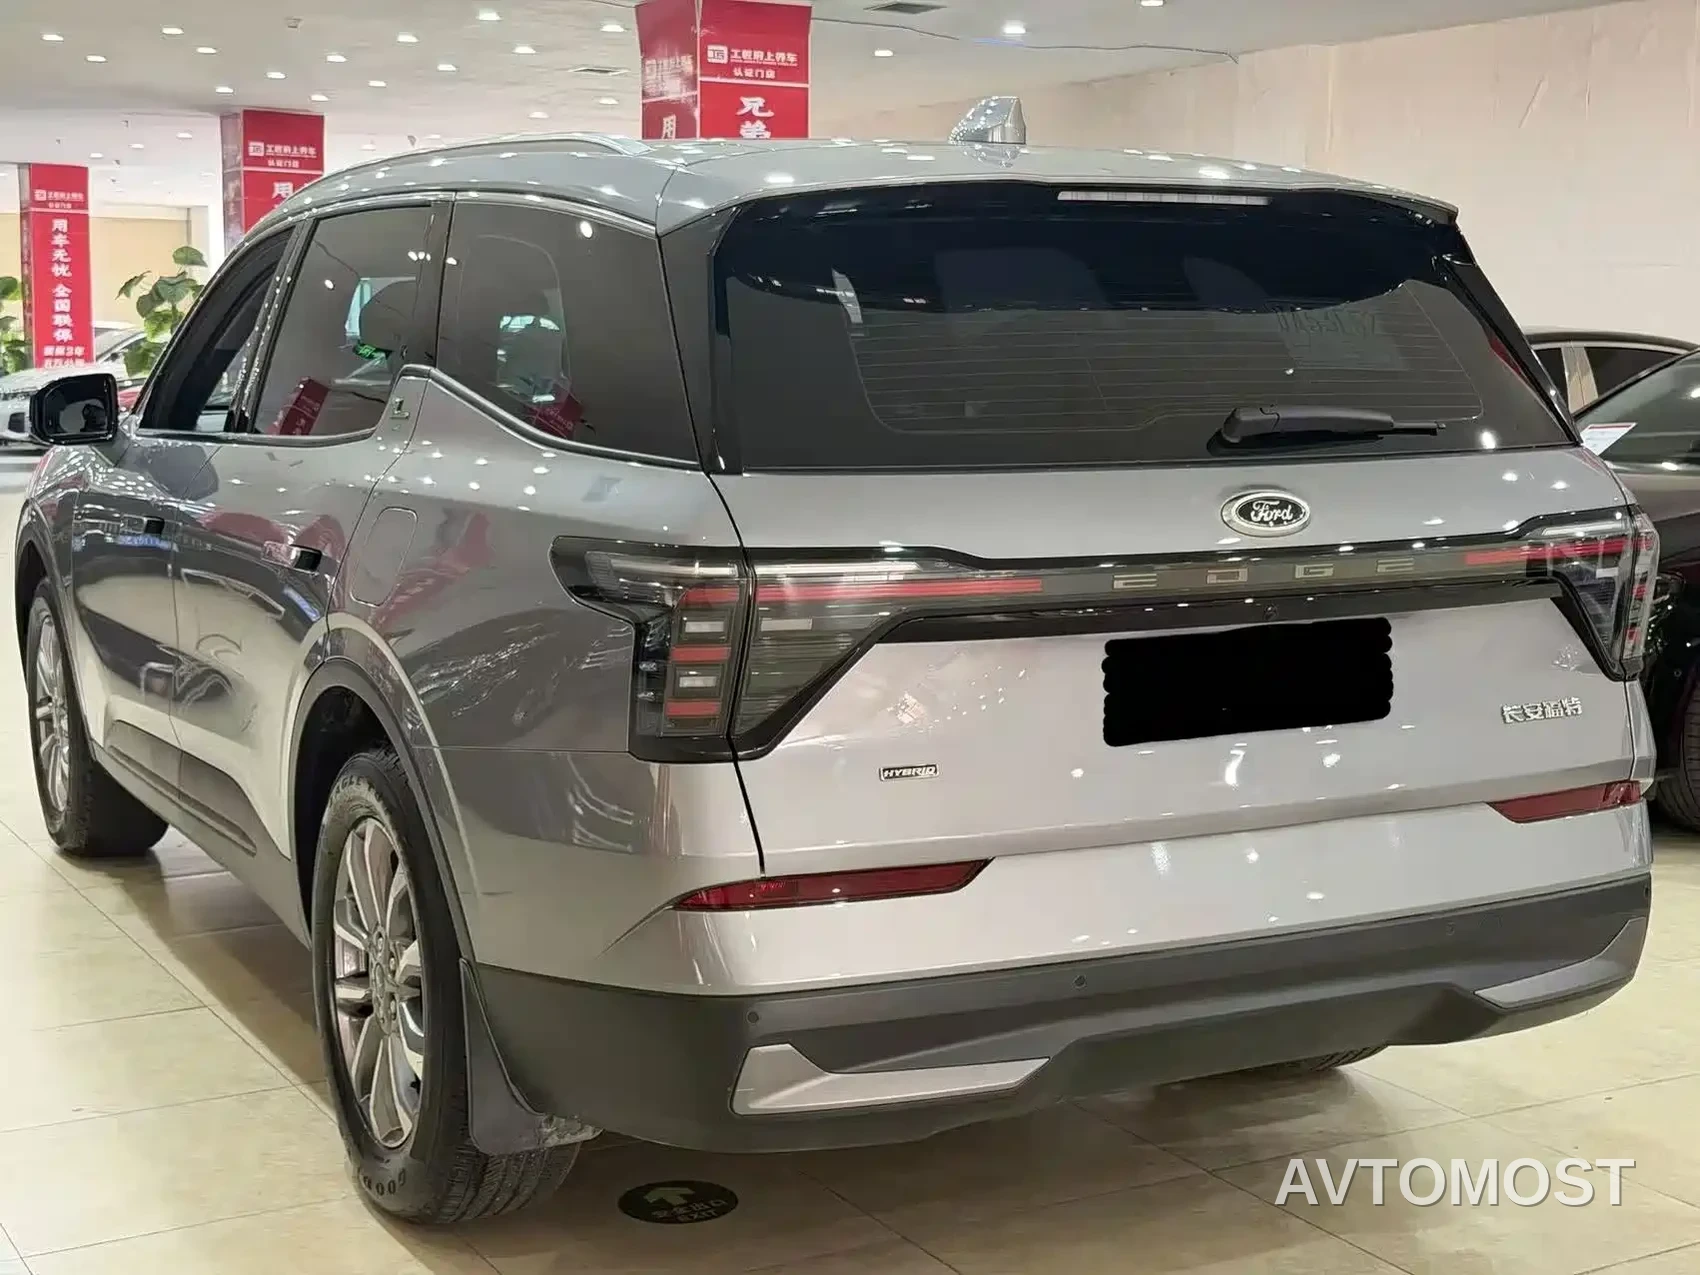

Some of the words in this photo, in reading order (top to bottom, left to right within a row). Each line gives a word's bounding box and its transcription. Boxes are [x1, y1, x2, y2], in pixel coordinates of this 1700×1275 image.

[1250, 500, 1294, 522] Ford
[1112, 557, 1415, 590] EDGE
[1502, 697, 1582, 722] 长安福特
[883, 766, 937, 778] HYBRID
